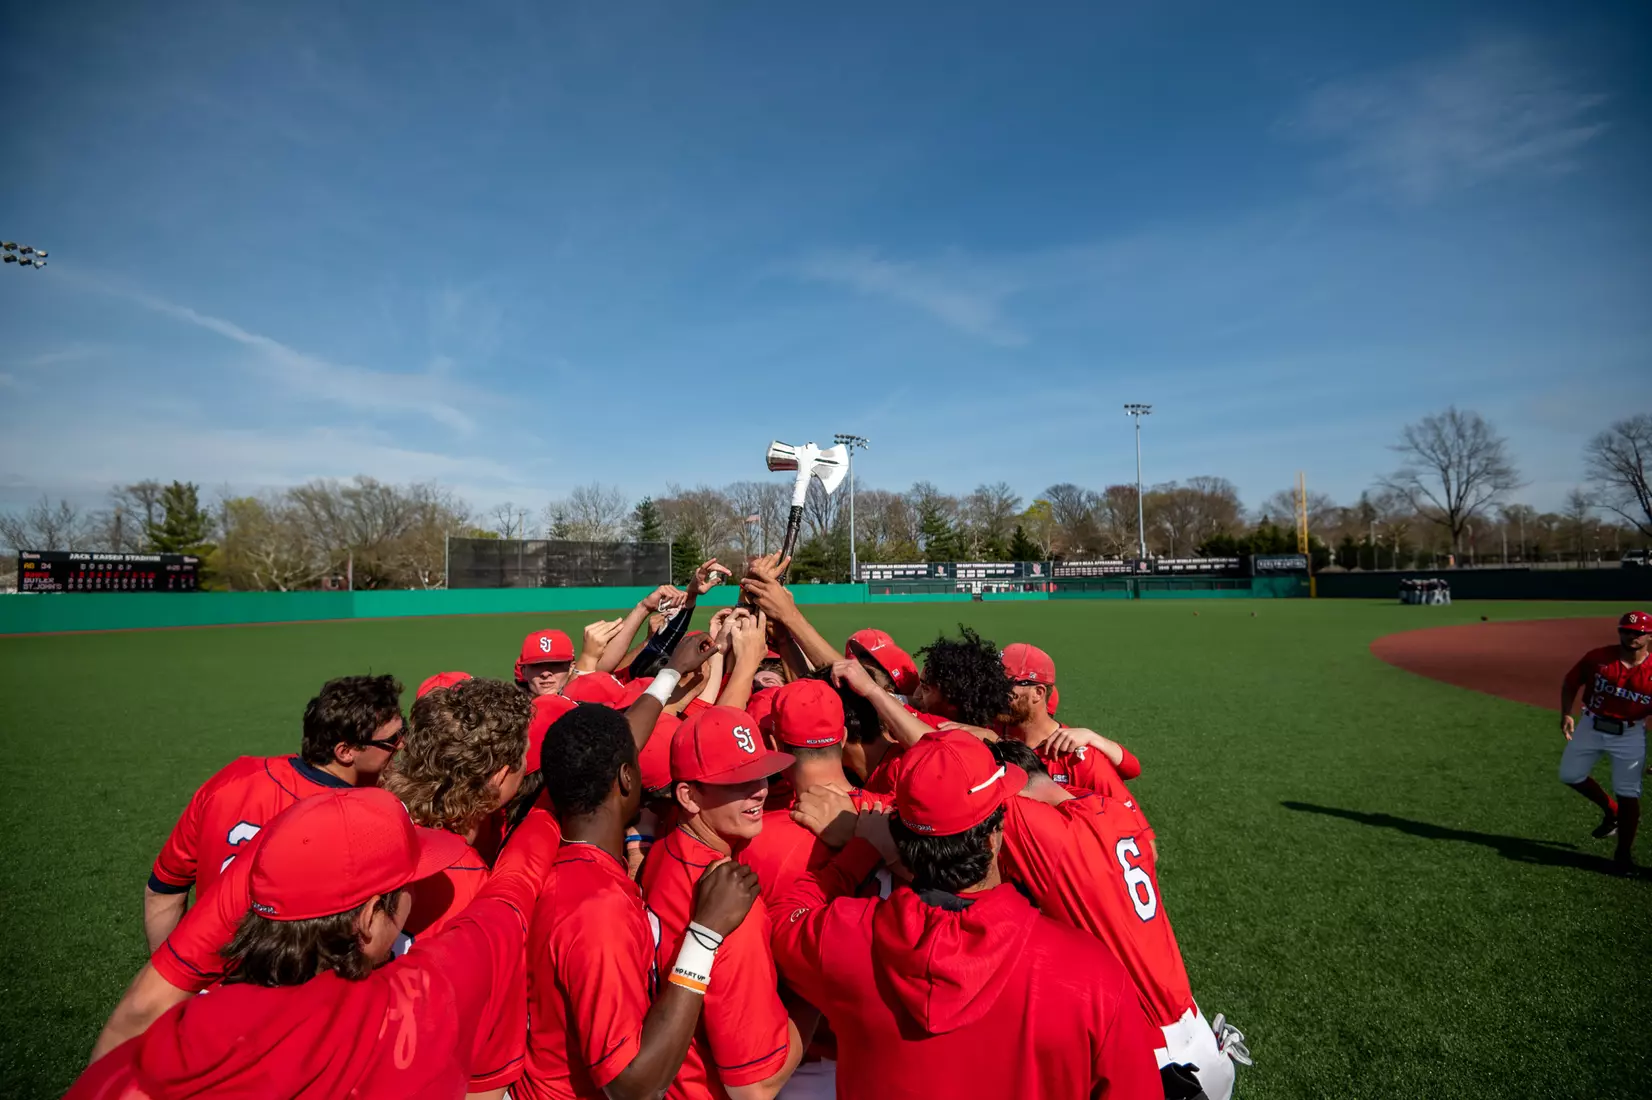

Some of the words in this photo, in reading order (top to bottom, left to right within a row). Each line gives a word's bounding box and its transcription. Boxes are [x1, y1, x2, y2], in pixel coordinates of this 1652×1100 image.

[92, 553, 124, 561] KAISER
[125, 554, 161, 562] STADIUM
[539, 636, 552, 653] SJ
[732, 725, 757, 754] SJ
[1115, 836, 1157, 922] 6
[684, 970, 697, 979] LET
